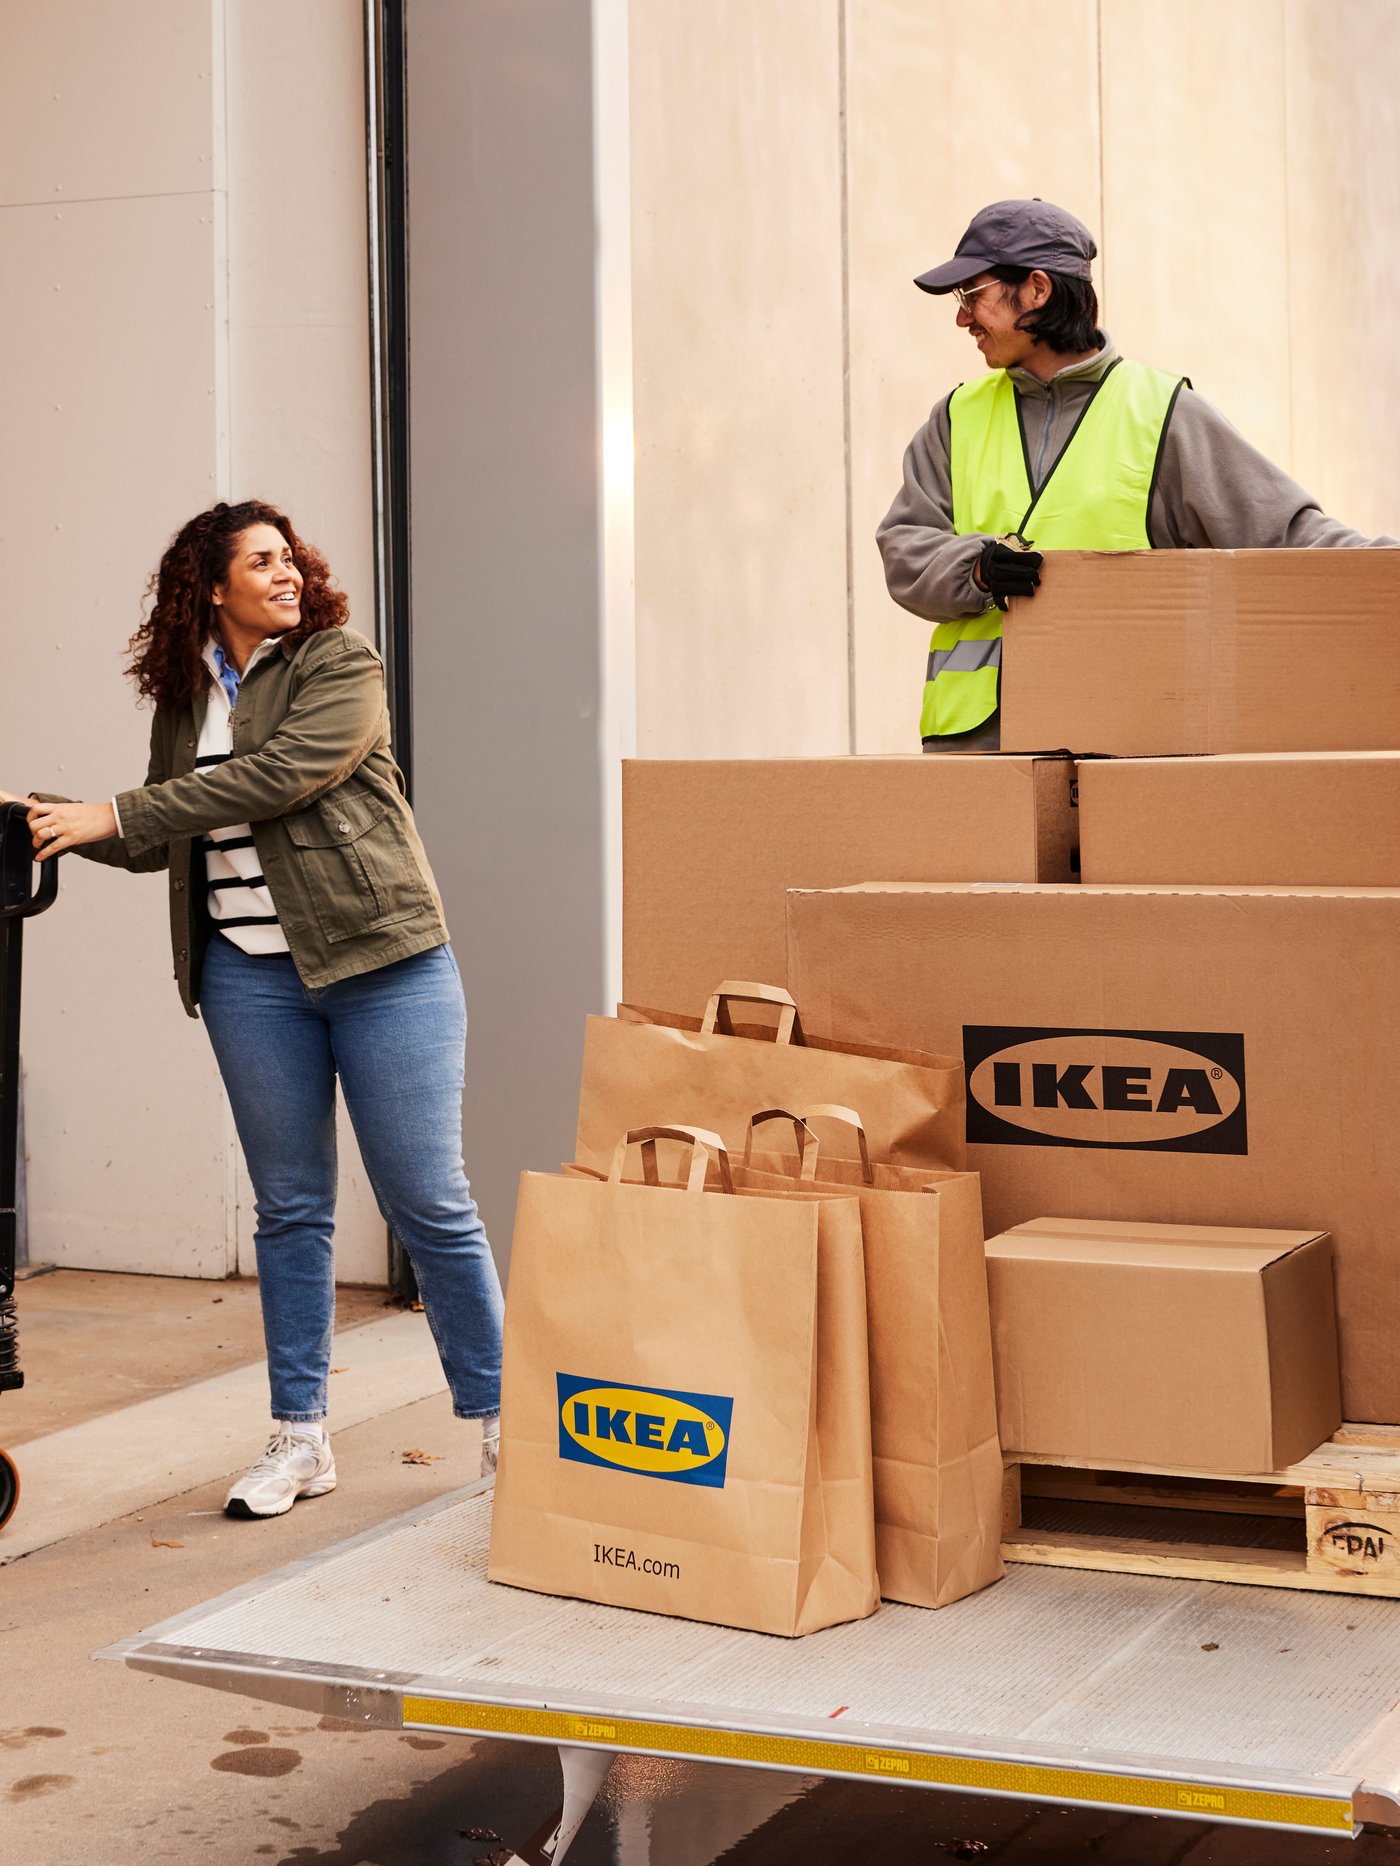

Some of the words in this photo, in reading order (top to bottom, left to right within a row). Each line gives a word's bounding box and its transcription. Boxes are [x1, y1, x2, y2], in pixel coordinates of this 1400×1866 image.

[993, 1061, 1223, 1115] IKEA
[573, 1401, 710, 1457] IKEA
[593, 1544, 680, 1579] IKEA.com
[588, 1723, 616, 1739] ZEPRO
[879, 1757, 910, 1772] ZEPRO
[1192, 1792, 1225, 1809] ZEPRO
